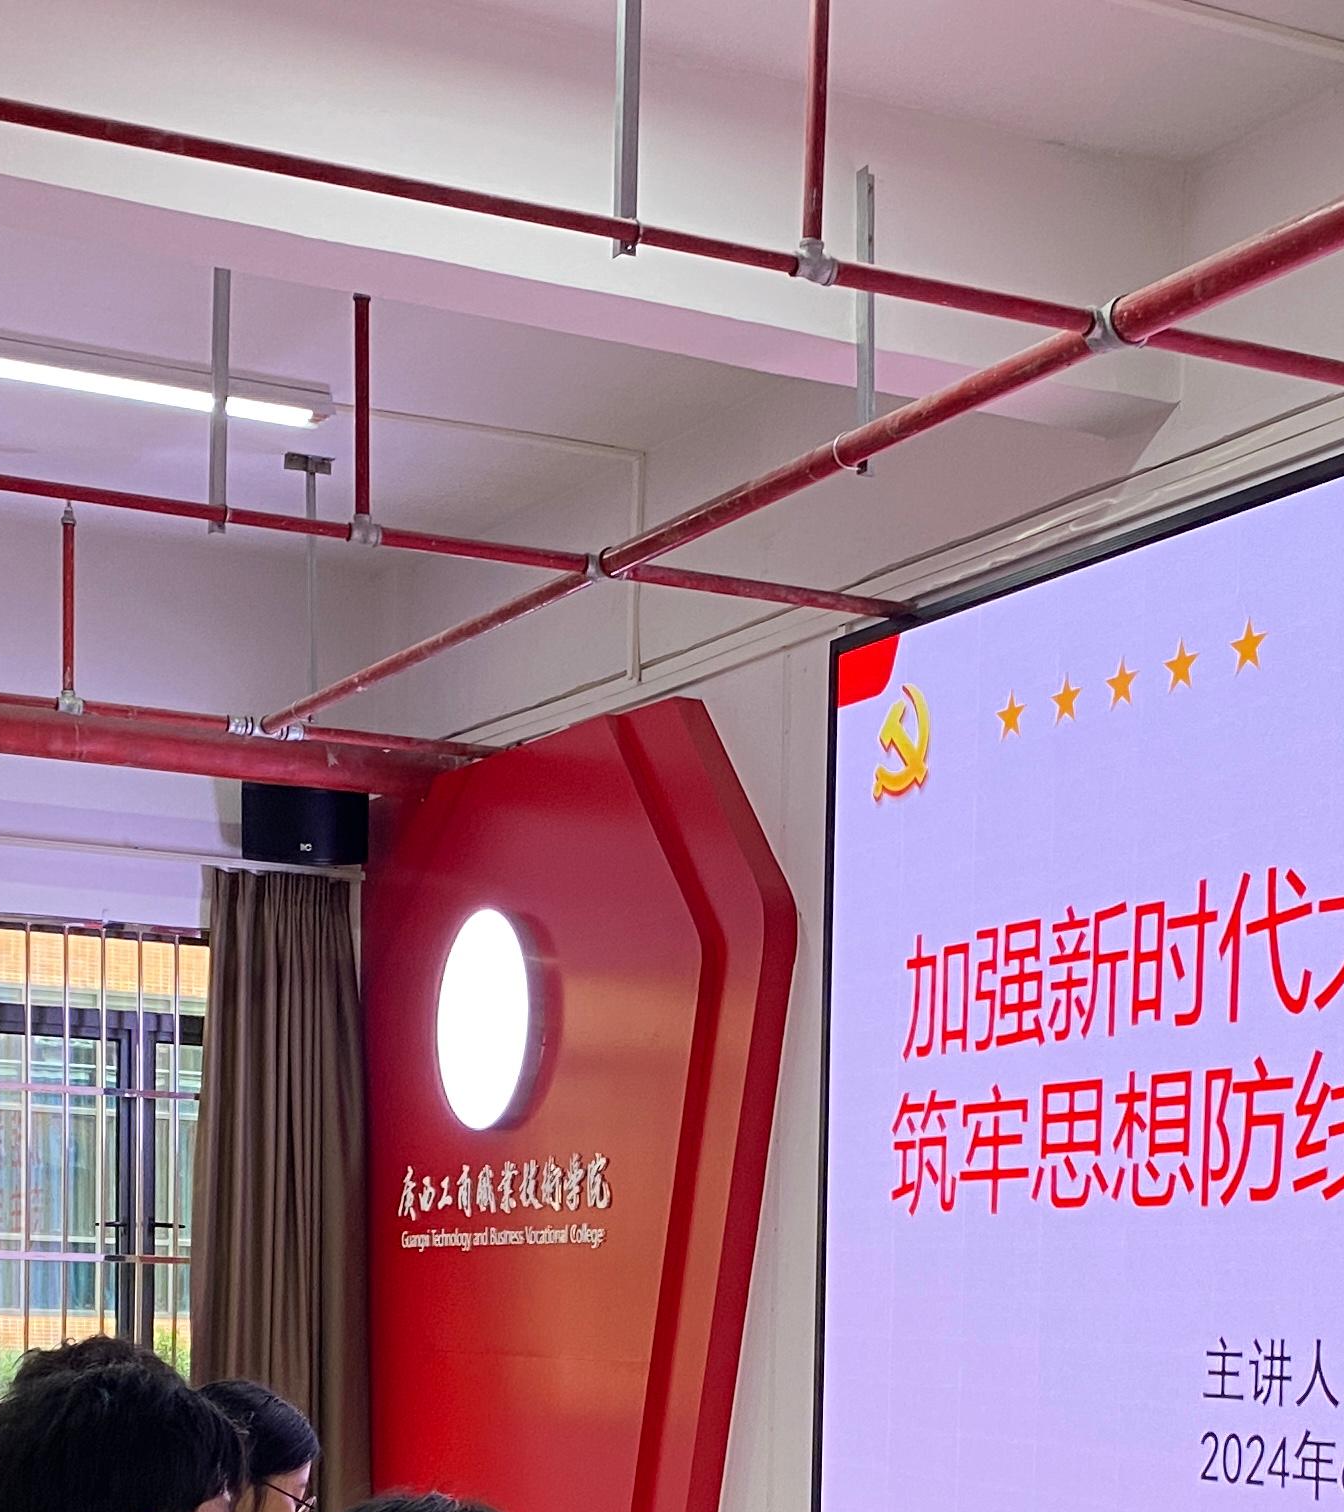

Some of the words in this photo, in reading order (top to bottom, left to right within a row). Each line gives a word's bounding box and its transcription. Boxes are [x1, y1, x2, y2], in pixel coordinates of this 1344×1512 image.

[431, 1227, 472, 1251] Technology
[473, 1226, 488, 1246] and
[489, 1226, 525, 1246] Business
[524, 1224, 569, 1245] Vocational
[569, 1222, 606, 1249] College
